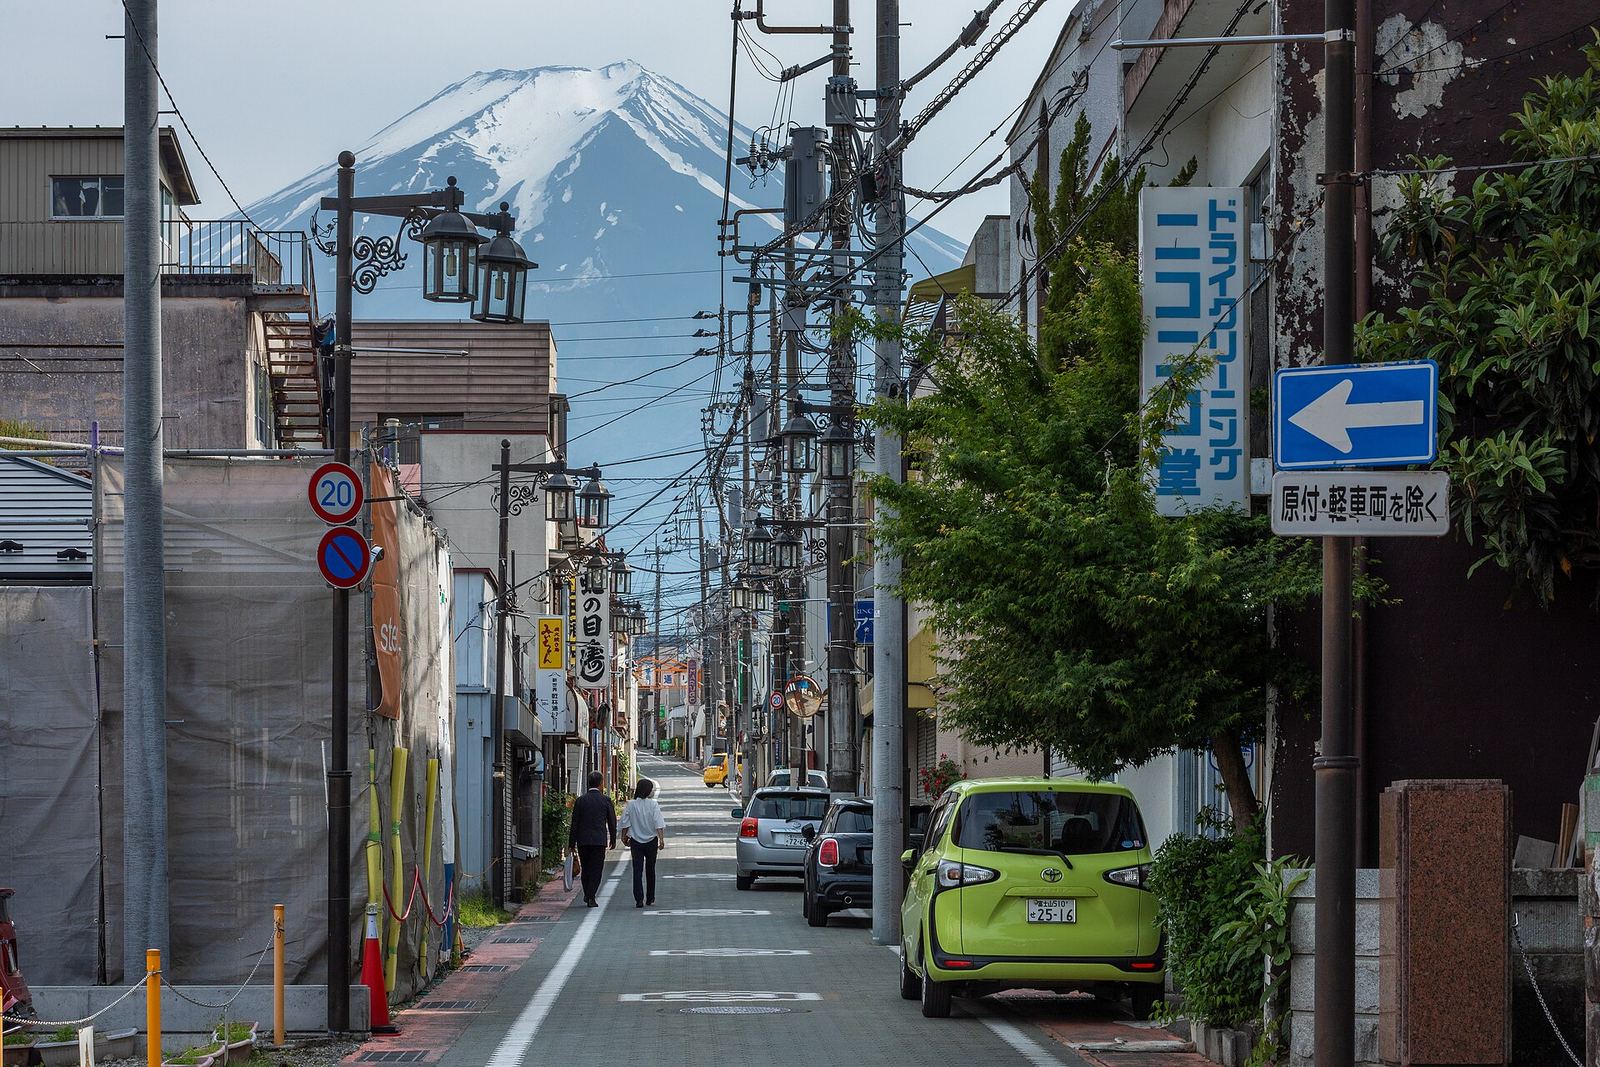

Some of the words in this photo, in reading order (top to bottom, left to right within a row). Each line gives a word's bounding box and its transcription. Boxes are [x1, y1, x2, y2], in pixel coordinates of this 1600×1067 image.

[1209, 199, 1242, 480] ドライクリーニング
[321, 480, 352, 507] 20
[1281, 484, 1438, 523] 原付・軽車両を除く
[1037, 908, 1073, 921] 25-16
